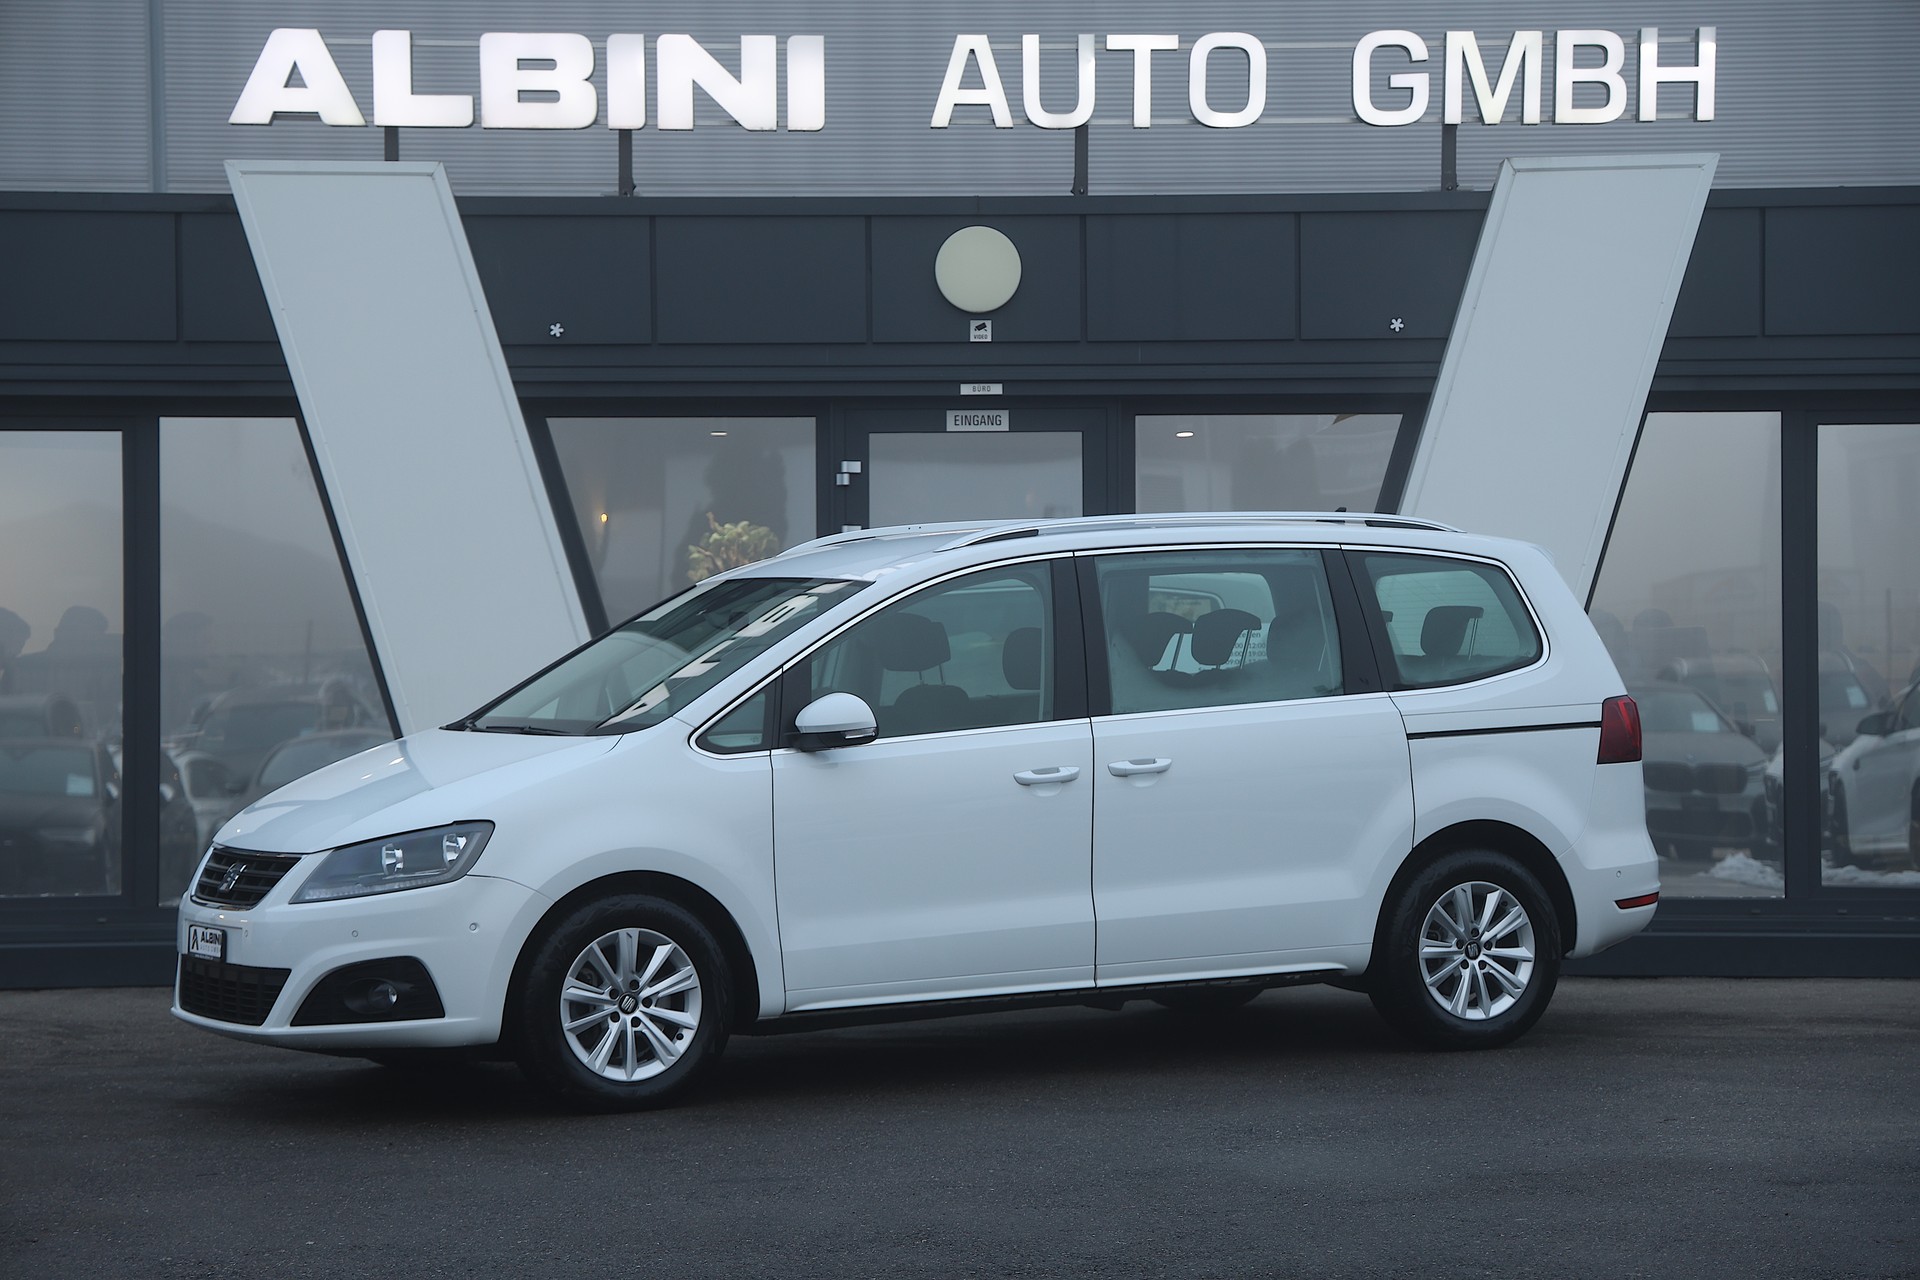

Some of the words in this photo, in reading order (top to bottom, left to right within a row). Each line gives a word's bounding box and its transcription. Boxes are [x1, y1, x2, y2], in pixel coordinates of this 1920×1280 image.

[228, 28, 826, 131] ALBINI
[930, 32, 1267, 129] AUTO
[1352, 27, 1718, 127] GMBH
[954, 414, 1002, 426] EINGANG
